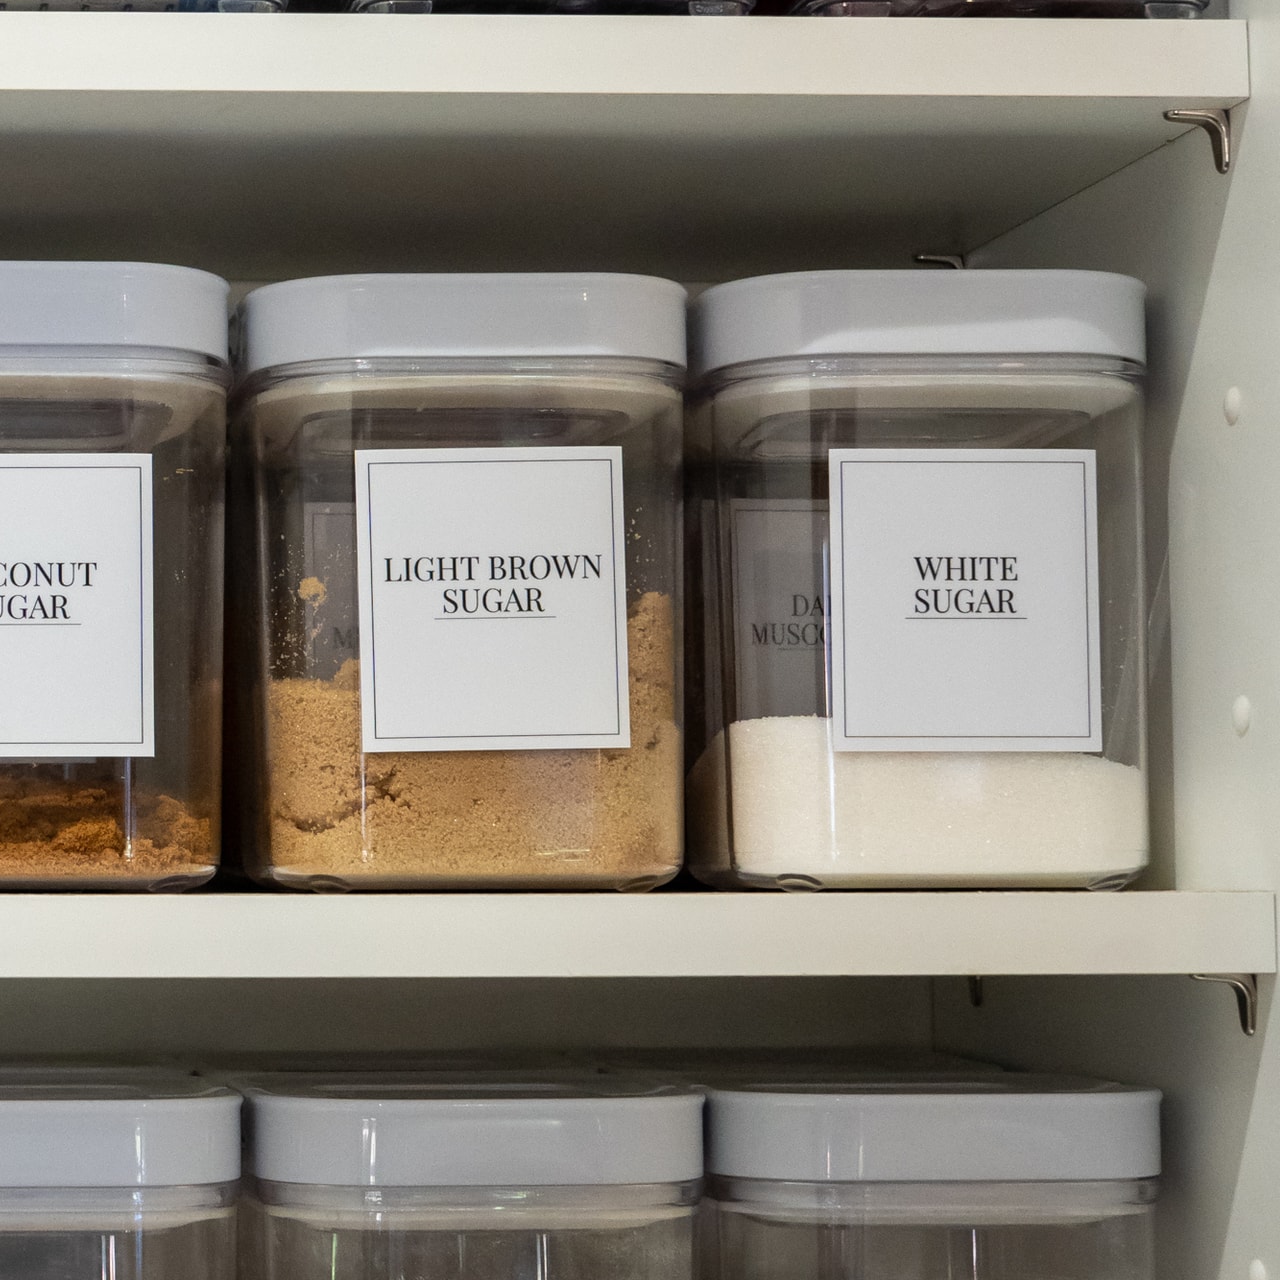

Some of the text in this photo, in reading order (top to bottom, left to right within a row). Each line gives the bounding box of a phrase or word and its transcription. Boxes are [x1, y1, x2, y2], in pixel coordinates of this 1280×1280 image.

[384, 554, 602, 583] LIGHT BROWN
[913, 556, 1018, 582] WHITE
[443, 587, 546, 614] SUGAR
[791, 595, 831, 617] DA
[914, 588, 1017, 614] SUGAR
